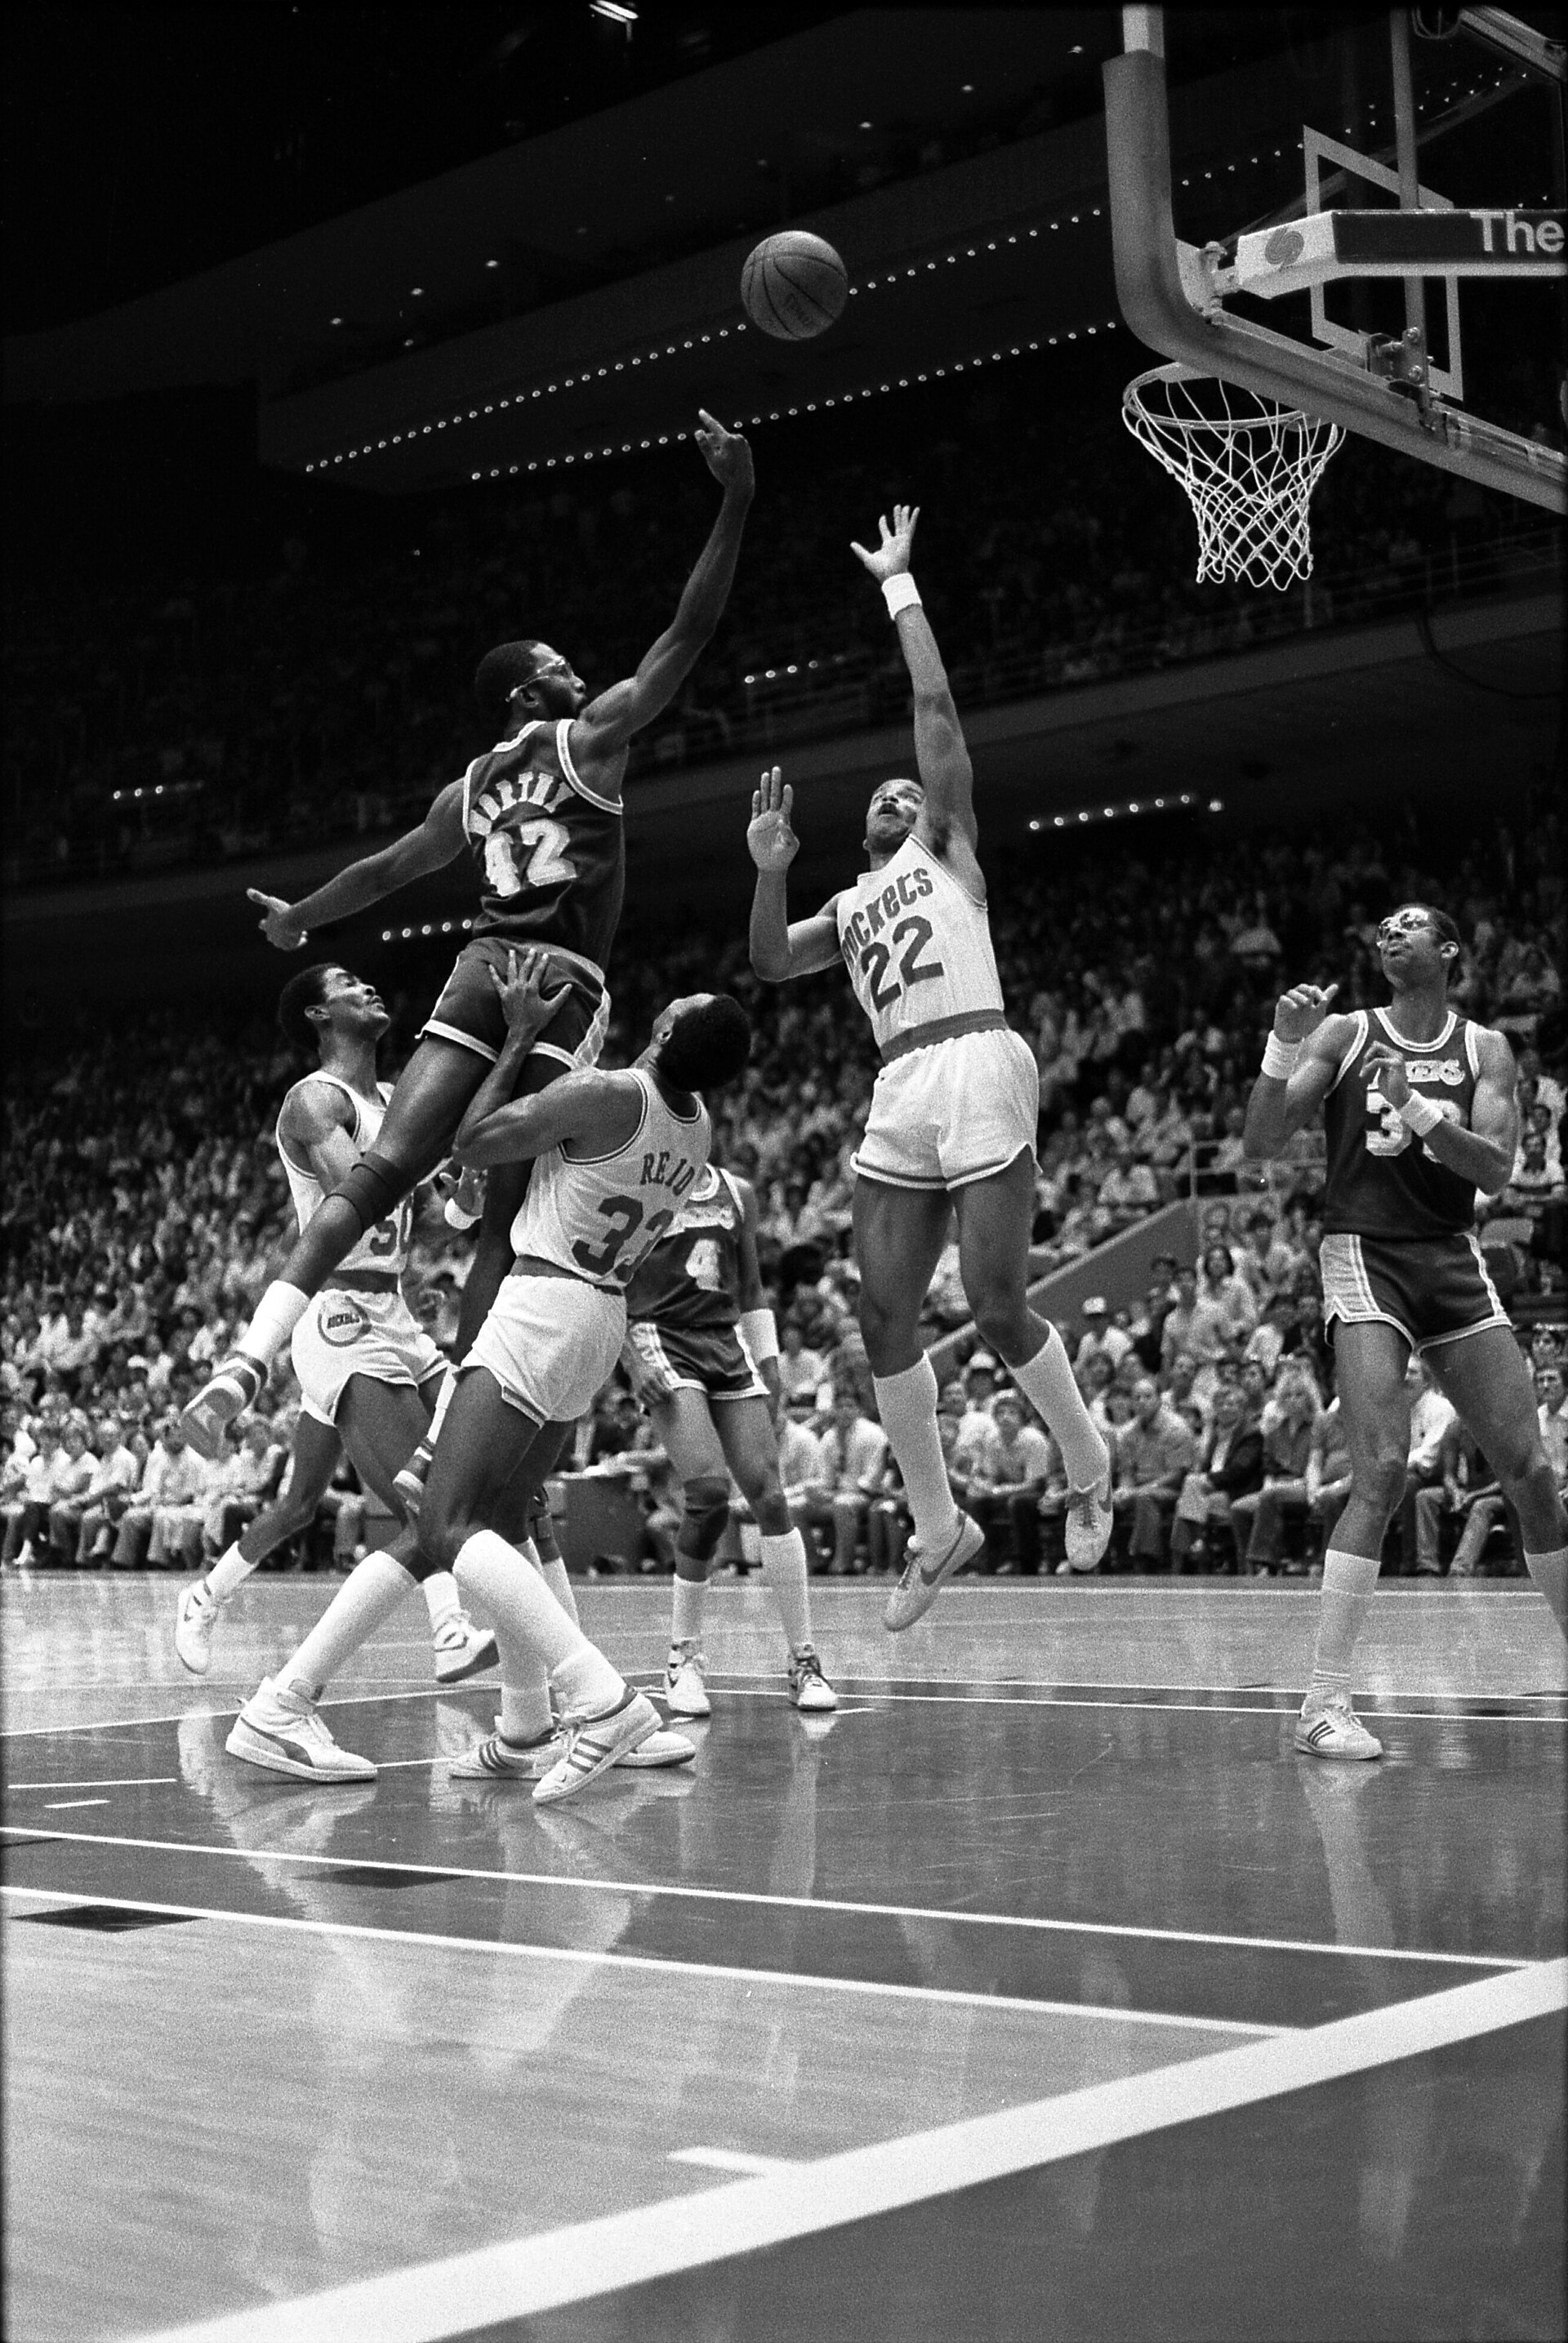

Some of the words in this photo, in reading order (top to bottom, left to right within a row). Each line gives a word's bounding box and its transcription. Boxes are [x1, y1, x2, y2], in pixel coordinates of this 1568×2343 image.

[1469, 211, 1566, 252] The
[483, 818, 578, 898] 42
[860, 915, 945, 1013] 22
[639, 1151, 695, 1196] REID
